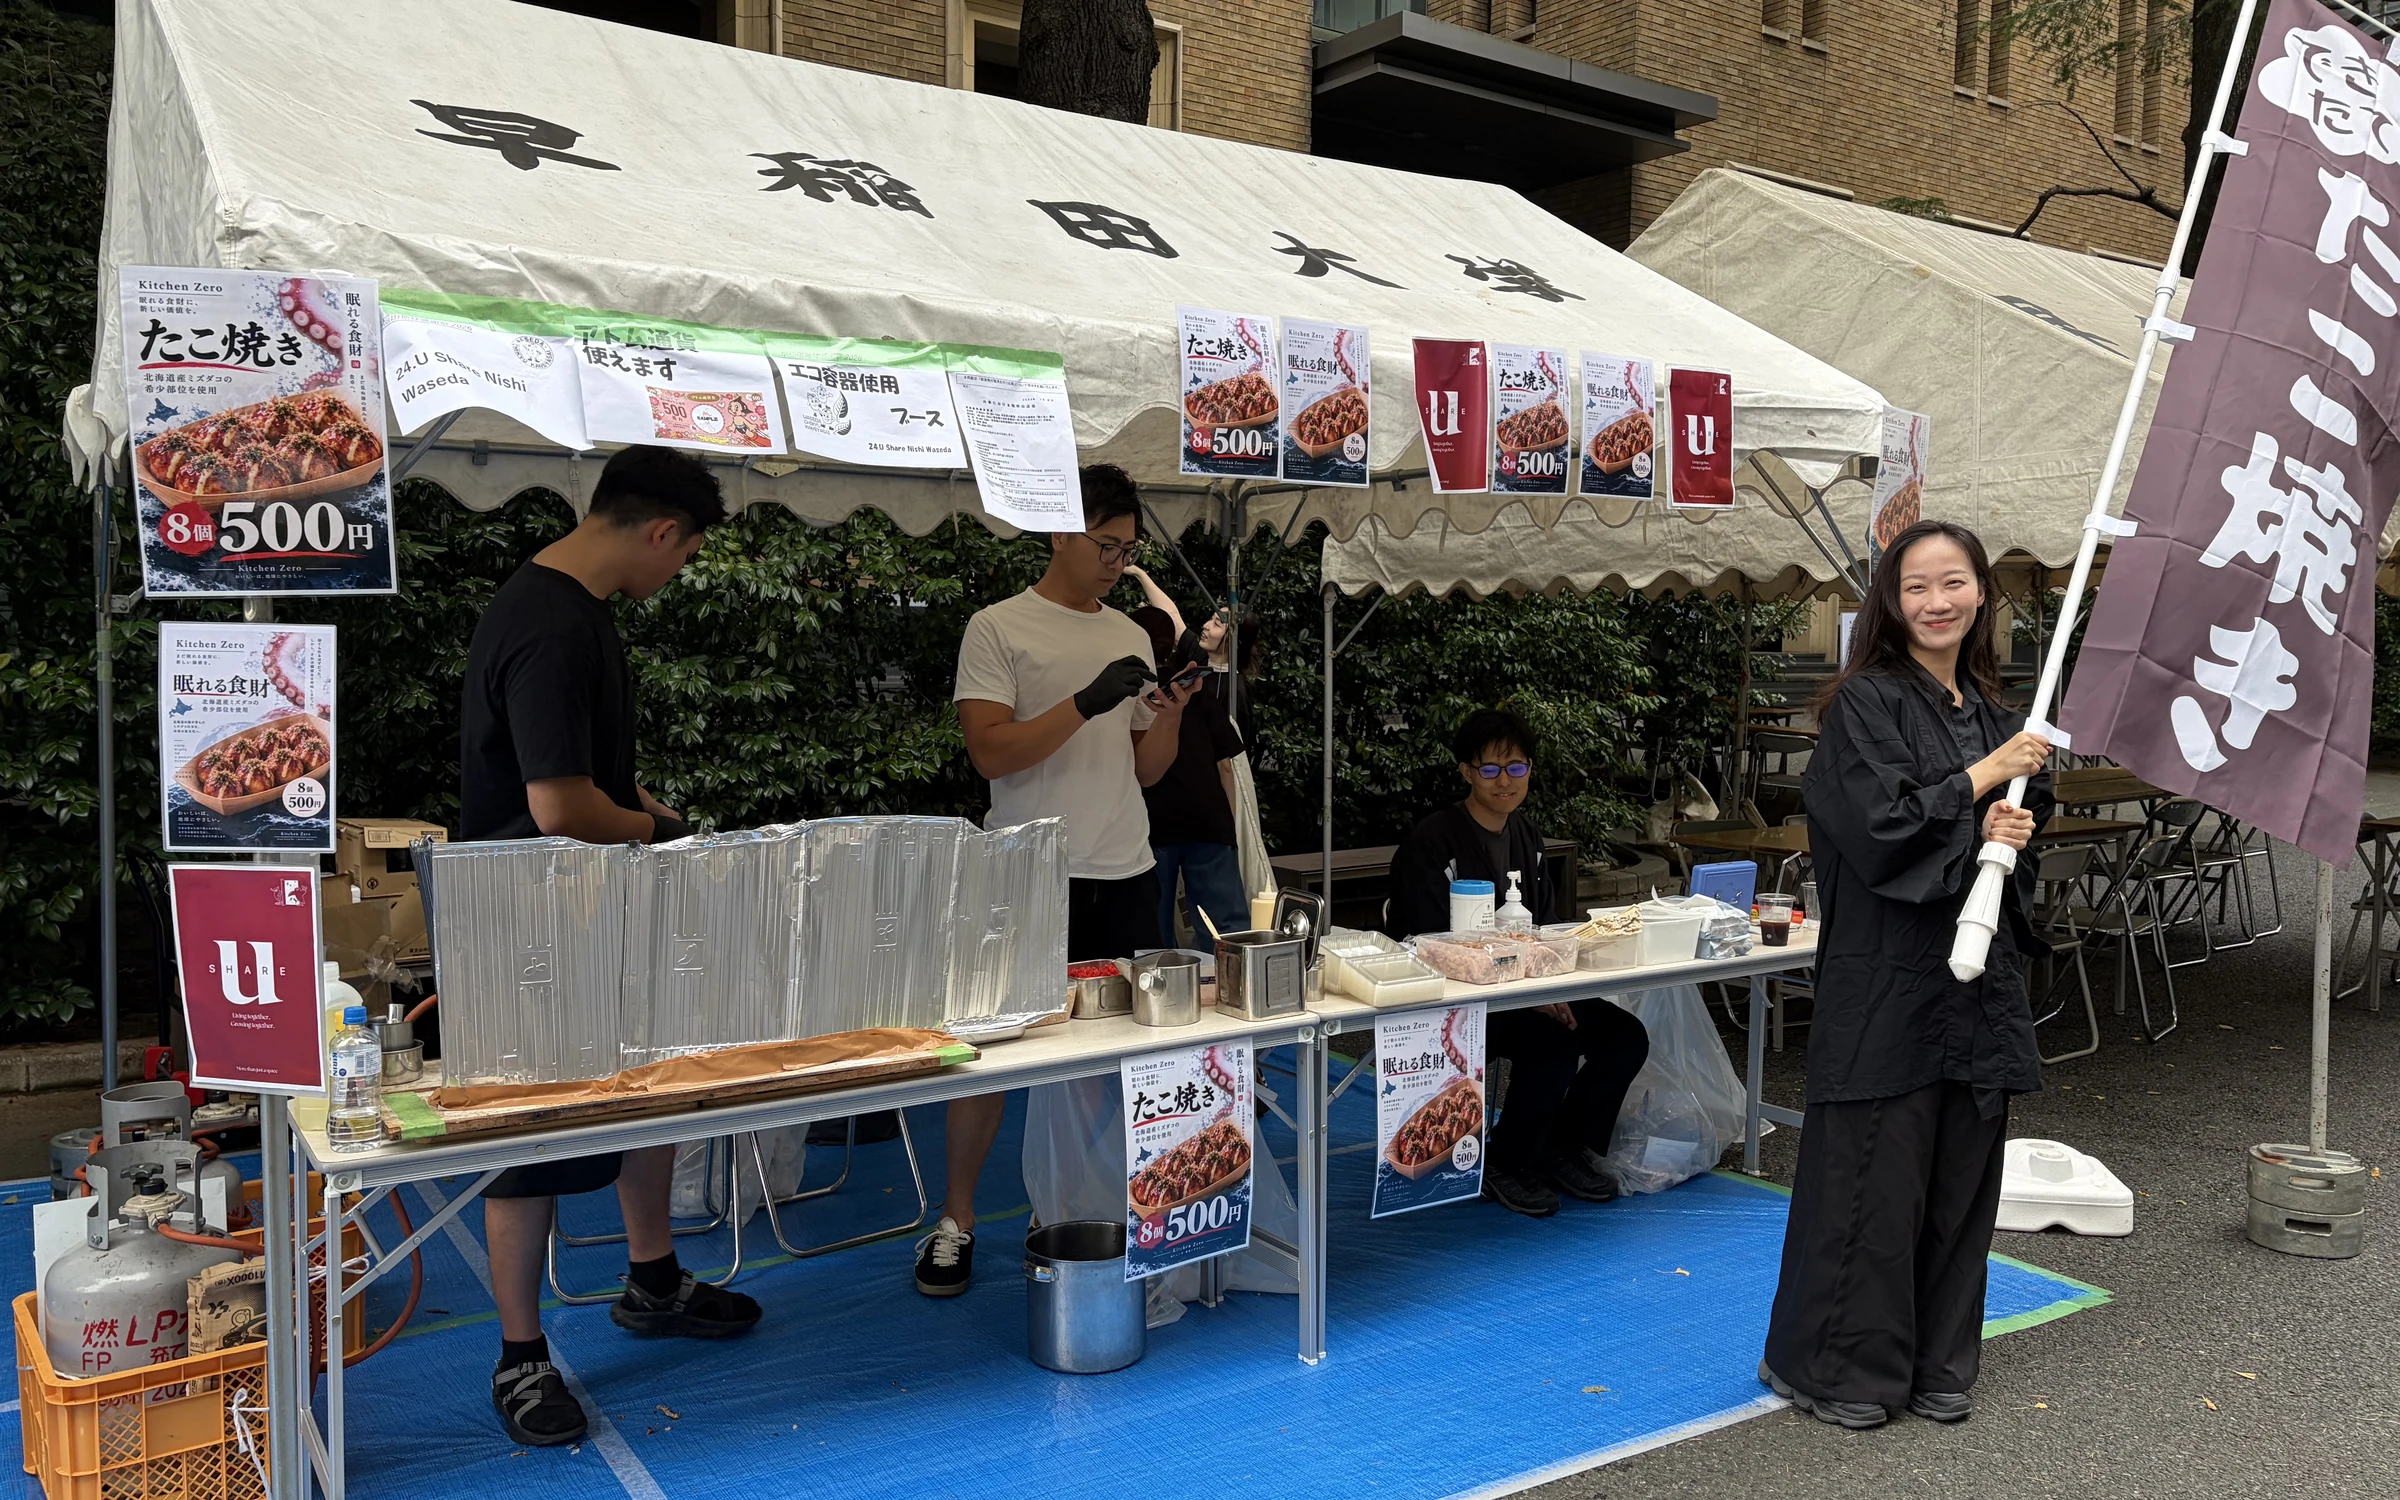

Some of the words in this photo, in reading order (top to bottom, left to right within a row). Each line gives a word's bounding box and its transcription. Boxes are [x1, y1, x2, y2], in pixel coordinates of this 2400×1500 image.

[2292, 34, 2379, 98] でき
[2308, 88, 2394, 155] たて
[138, 280, 189, 291] Kitchen
[194, 282, 223, 293] Zero
[345, 292, 363, 357] 眠れる食財
[1288, 329, 1310, 338] Kitchen
[138, 318, 303, 367] たこ焼き
[573, 324, 699, 353] アトム通貨
[1186, 333, 1248, 361] たこ焼き
[395, 351, 429, 381] 24.U
[434, 351, 481, 378] Share
[484, 370, 527, 392] Nishi
[582, 345, 678, 381] 使えます
[1288, 354, 1338, 375] 眠れる食財
[143, 373, 232, 384] 北海道産ミズダコの
[144, 384, 217, 395] 希少部位を使用
[401, 373, 470, 403] Waseda
[787, 363, 900, 395] エコ容器使用
[1499, 368, 1546, 391] たこ焼き
[1587, 383, 1629, 401] 眠れる食財
[661, 402, 688, 419] 500
[889, 407, 945, 428] ブース
[1192, 431, 1211, 448] 8個
[1212, 427, 1273, 456] 500円
[1681, 429, 1719, 438] SHARE
[885, 443, 906, 452] Share
[907, 445, 925, 453] Nishi
[925, 446, 952, 454] Waseda
[1501, 455, 1515, 470] 8個
[1517, 451, 1564, 475] 500円
[2170, 166, 2400, 773] たこ焼き
[166, 512, 215, 545] 8個
[219, 501, 374, 552] 500円
[176, 639, 217, 649] Kitchen
[220, 640, 245, 649] Zero
[173, 674, 270, 699] 眠れる食財
[201, 698, 259, 706] 北海道産ミズダコの
[297, 782, 314, 793] 8個
[288, 796, 322, 809] 500円
[208, 963, 287, 977] SHARE
[1383, 1024, 1411, 1034] Kitchen
[1130, 1063, 1158, 1073] Kitchen
[1382, 1051, 1446, 1075] 眠れる食財
[1132, 1081, 1215, 1123] たこ焼き
[1455, 1151, 1477, 1165] 500円
[1140, 1221, 1164, 1243] 8個
[1165, 1195, 1242, 1241] 500円
[82, 1317, 119, 1349] 燃
[82, 1351, 112, 1372] FP
